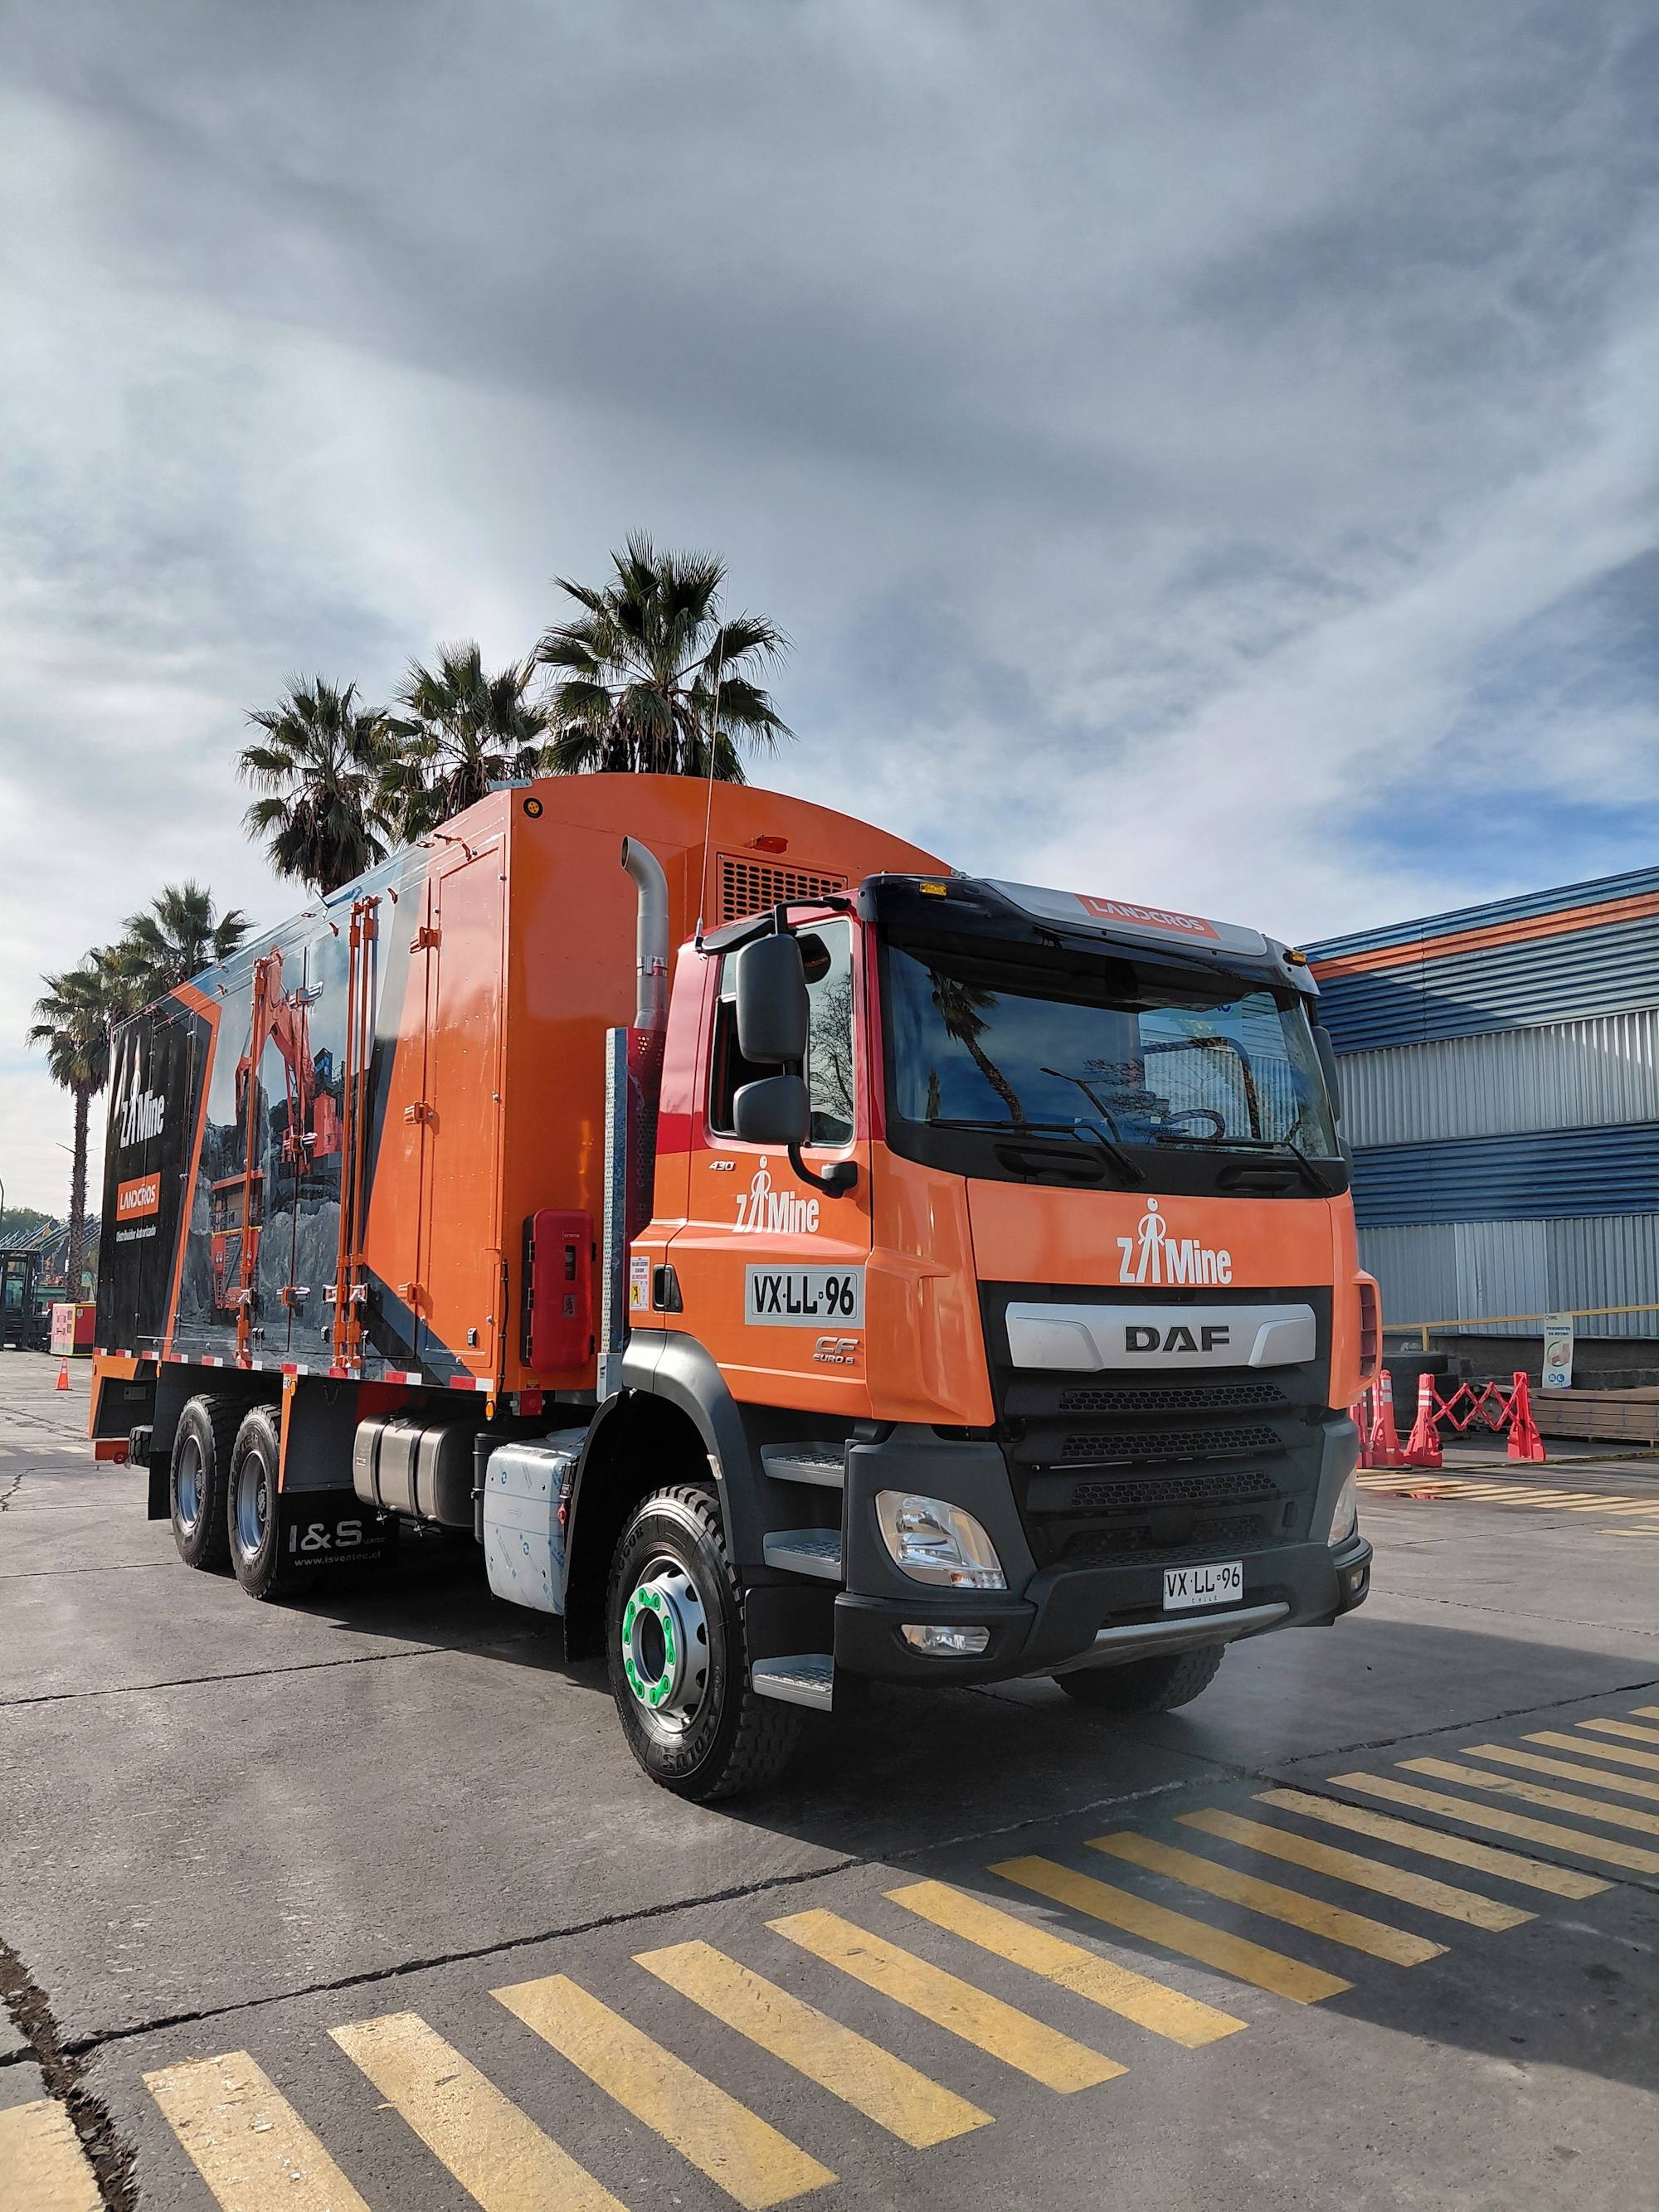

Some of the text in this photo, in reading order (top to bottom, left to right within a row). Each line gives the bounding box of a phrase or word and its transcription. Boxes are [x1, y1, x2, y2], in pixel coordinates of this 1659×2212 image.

[1088, 899, 1205, 931] LANDCROS
[708, 1160, 736, 1171] 430
[119, 1184, 157, 1211] LANDCROS
[815, 1336, 859, 1354] CF
[1125, 1326, 1230, 1352] DAF
[812, 1353, 843, 1364] EURO
